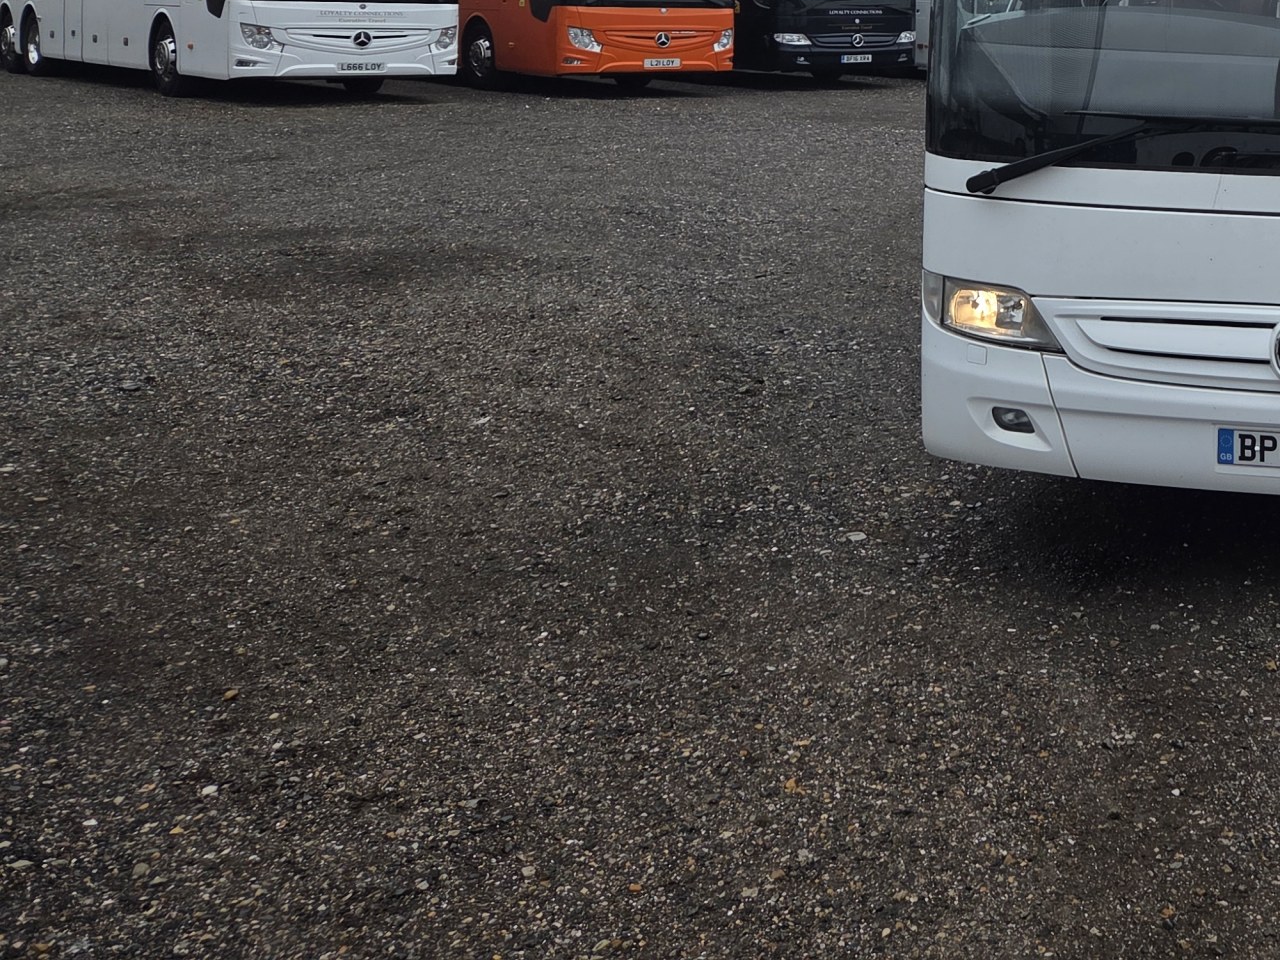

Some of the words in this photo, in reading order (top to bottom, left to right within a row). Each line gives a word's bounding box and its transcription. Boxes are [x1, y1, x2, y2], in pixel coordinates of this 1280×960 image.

[340, 63, 364, 71] L666
[364, 63, 382, 71] LOY
[1219, 452, 1233, 461] GB
